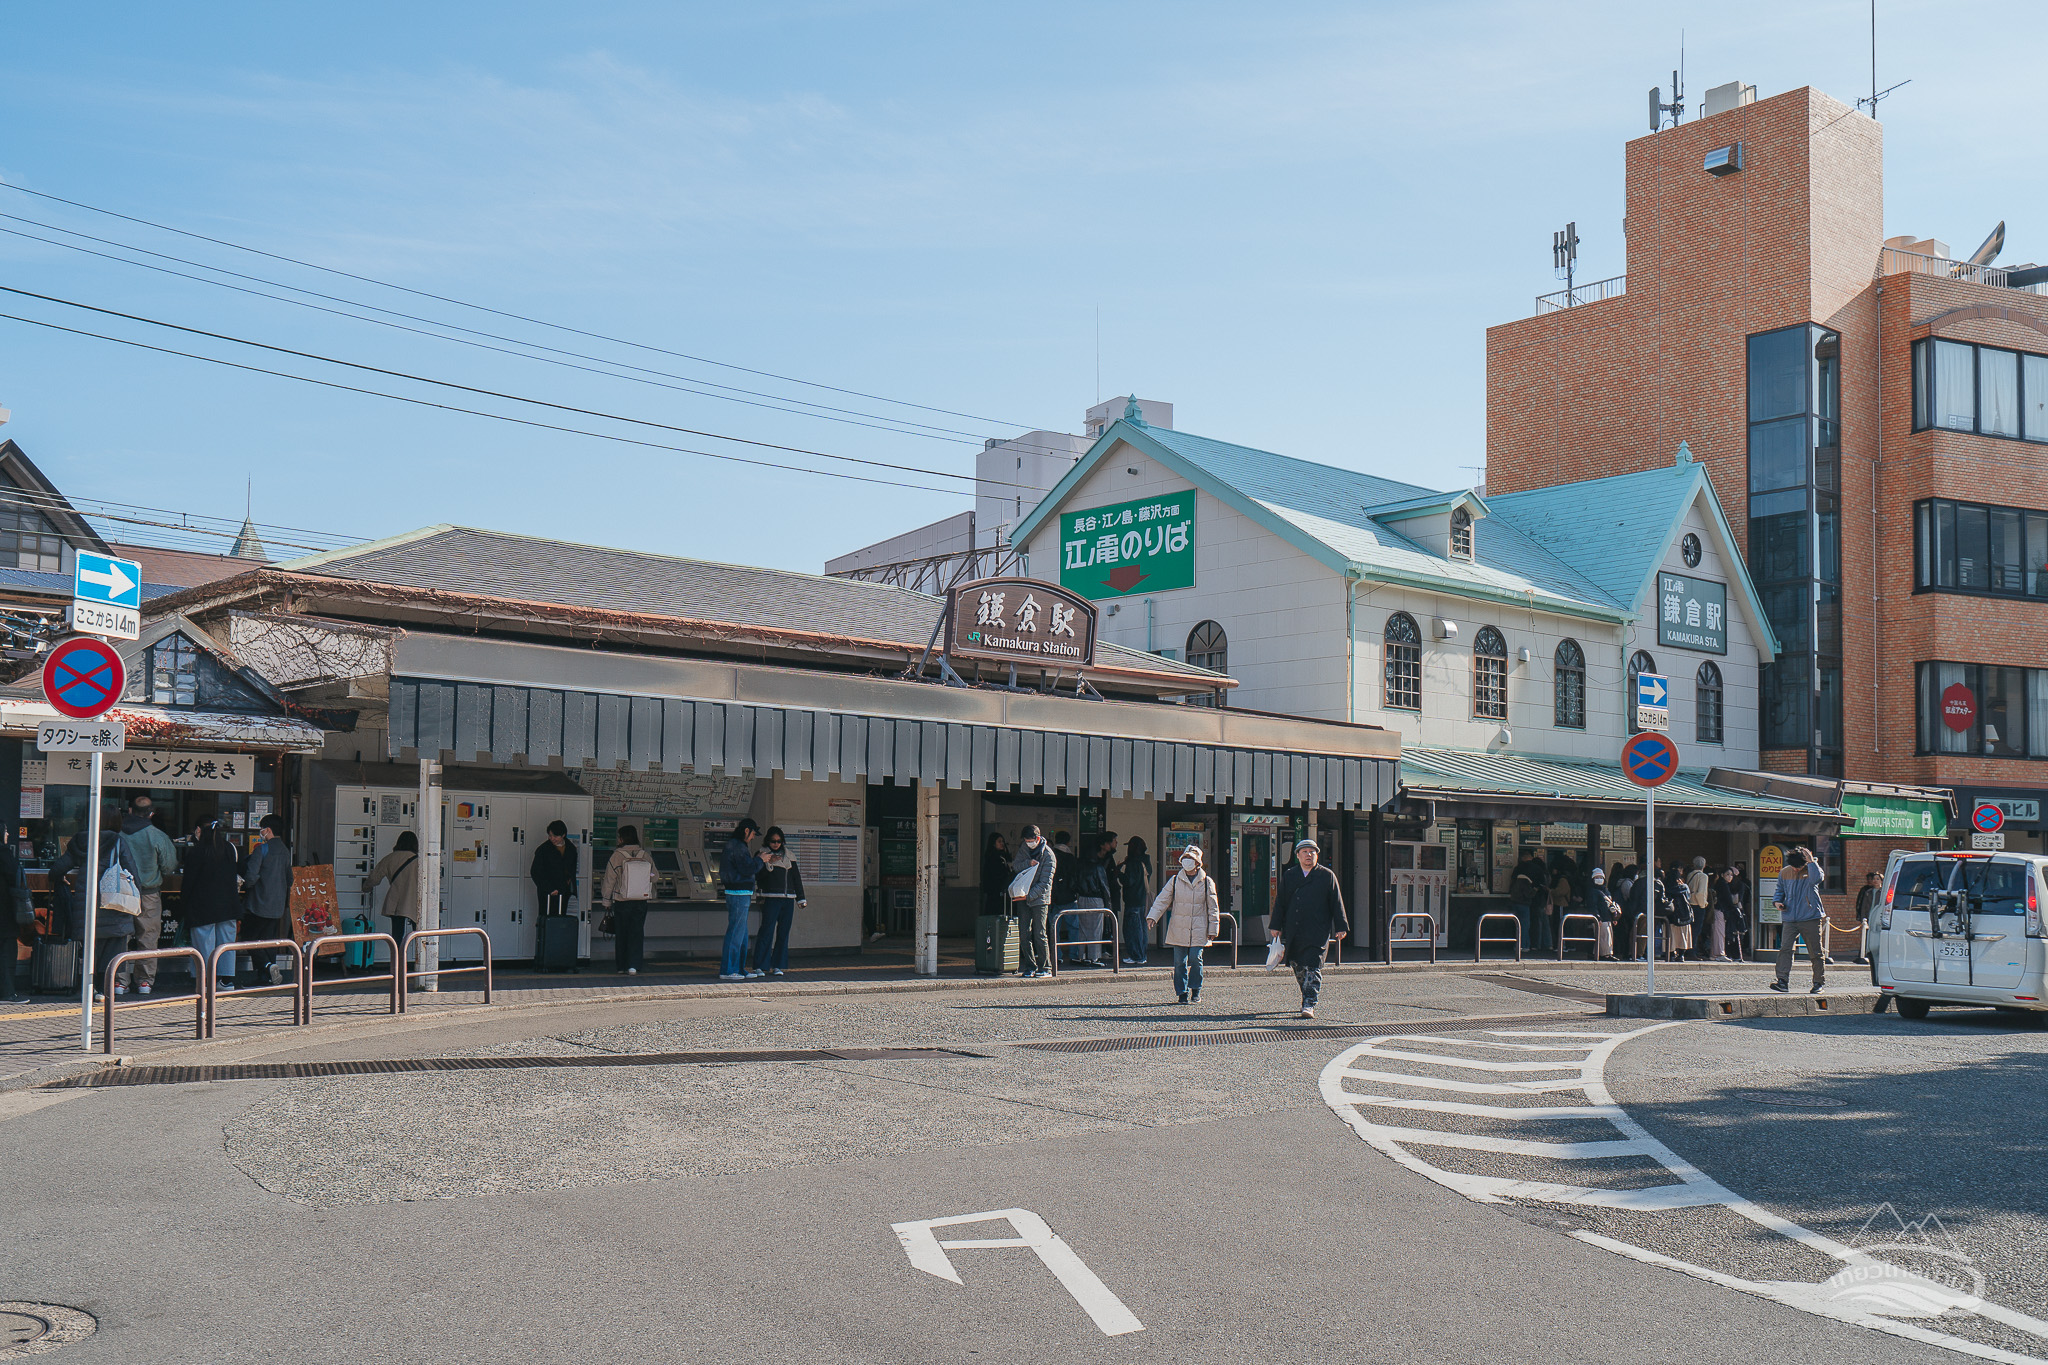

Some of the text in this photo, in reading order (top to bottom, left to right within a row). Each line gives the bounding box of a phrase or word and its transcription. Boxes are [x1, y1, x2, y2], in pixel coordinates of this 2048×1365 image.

[1073, 503, 1180, 533] 長谷・江ノ島・藤沢方面
[1065, 519, 1192, 570] 江ノ電のりば
[76, 607, 136, 635] ここから14m
[977, 590, 1075, 637] 鎌倉駅
[1663, 593, 1722, 632] 鎌倉駅
[967, 631, 1081, 657] JR Kamakura Station
[1667, 630, 1720, 648] KAMAKURA STA.
[1639, 711, 1668, 727] ここから14m
[43, 728, 119, 747] タクシーを除く
[124, 757, 236, 780] パンダ焼き
[1860, 816, 1891, 828] KAMAKURA
[1891, 818, 1914, 829] STATION
[1761, 856, 1782, 865] TAXI
[1761, 865, 1782, 873] のりば
[296, 882, 327, 896] いちご
[1400, 923, 1407, 939] 2
[1416, 923, 1424, 939] 3
